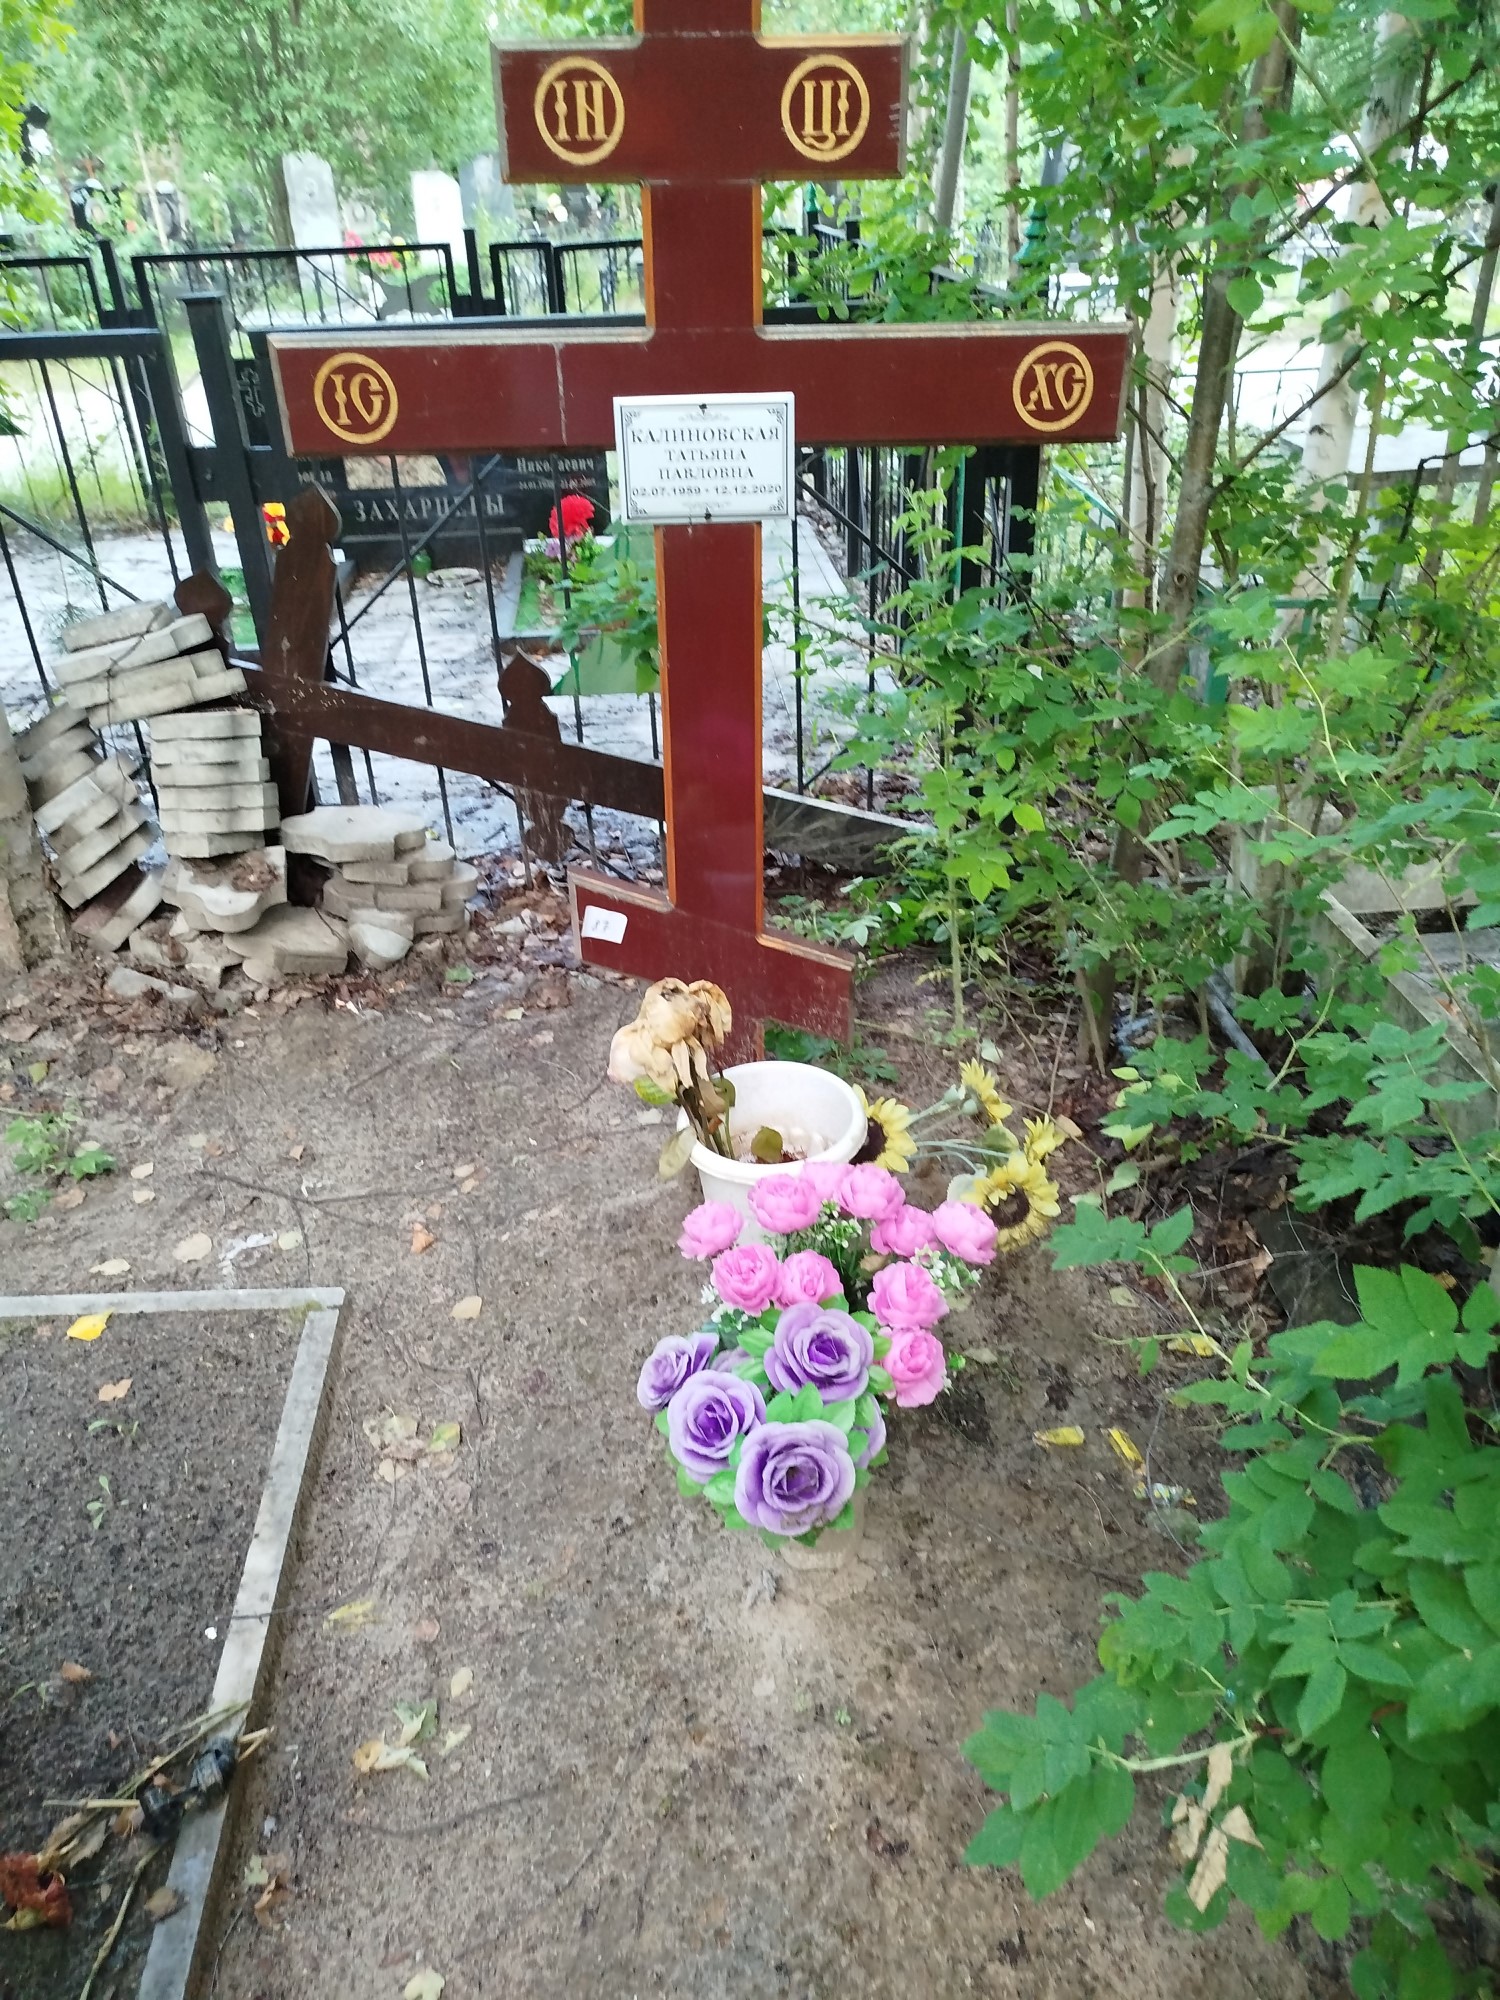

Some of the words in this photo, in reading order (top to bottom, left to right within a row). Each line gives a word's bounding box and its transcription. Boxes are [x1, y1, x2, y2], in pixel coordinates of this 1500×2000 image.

[631, 425, 780, 444] КАЛИНОВСКАЯ
[666, 448, 747, 462] ТАТЬЯНА
[516, 457, 595, 474] Никоаевич
[658, 466, 754, 480] ПАВЛОВНА
[714, 483, 783, 495] 12.12.2020
